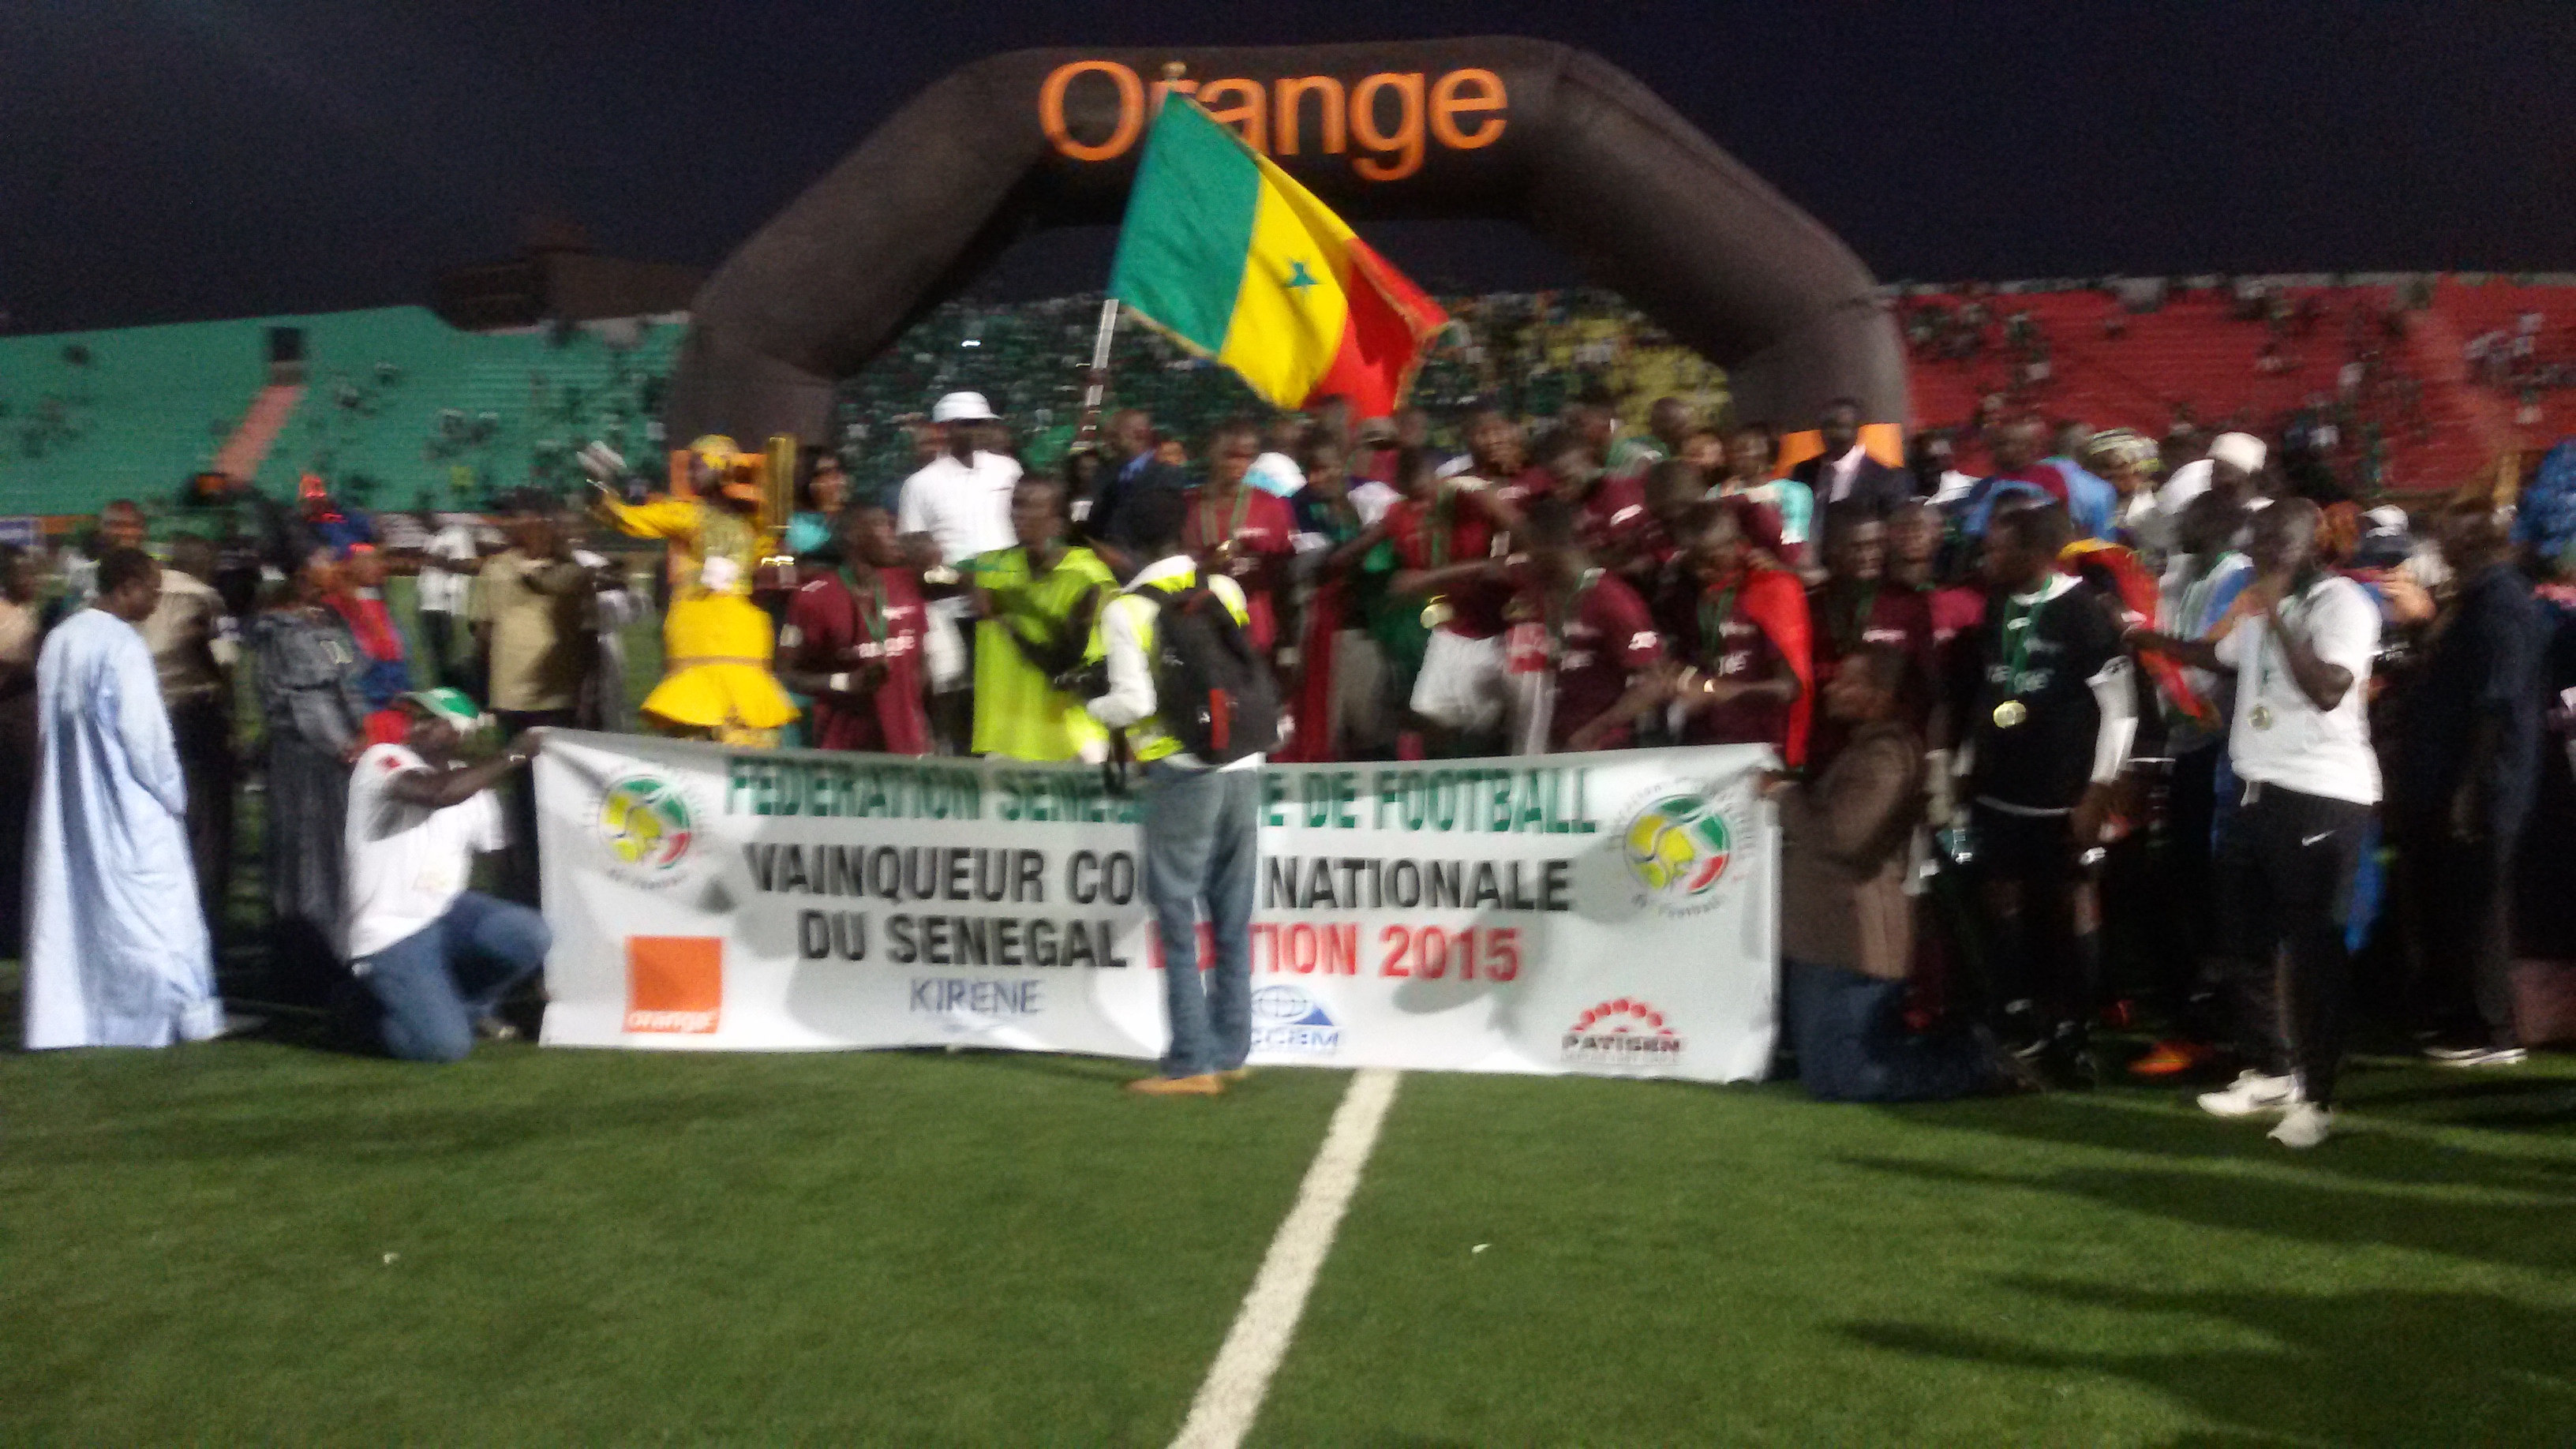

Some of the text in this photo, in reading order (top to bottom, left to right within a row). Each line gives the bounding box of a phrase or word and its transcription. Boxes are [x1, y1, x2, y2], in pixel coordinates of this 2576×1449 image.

[724, 754, 979, 821] FEDERATION
[1298, 770, 1357, 829] DE
[1374, 766, 1597, 834] FOOTBALL
[743, 842, 1045, 904] VAINQUEUR
[1263, 856, 1571, 912] NATIONALE
[799, 908, 867, 960] DU
[885, 913, 1129, 968] SENEGAL
[1380, 924, 1522, 983] 2015
[910, 978, 1044, 1014] KIRENE
